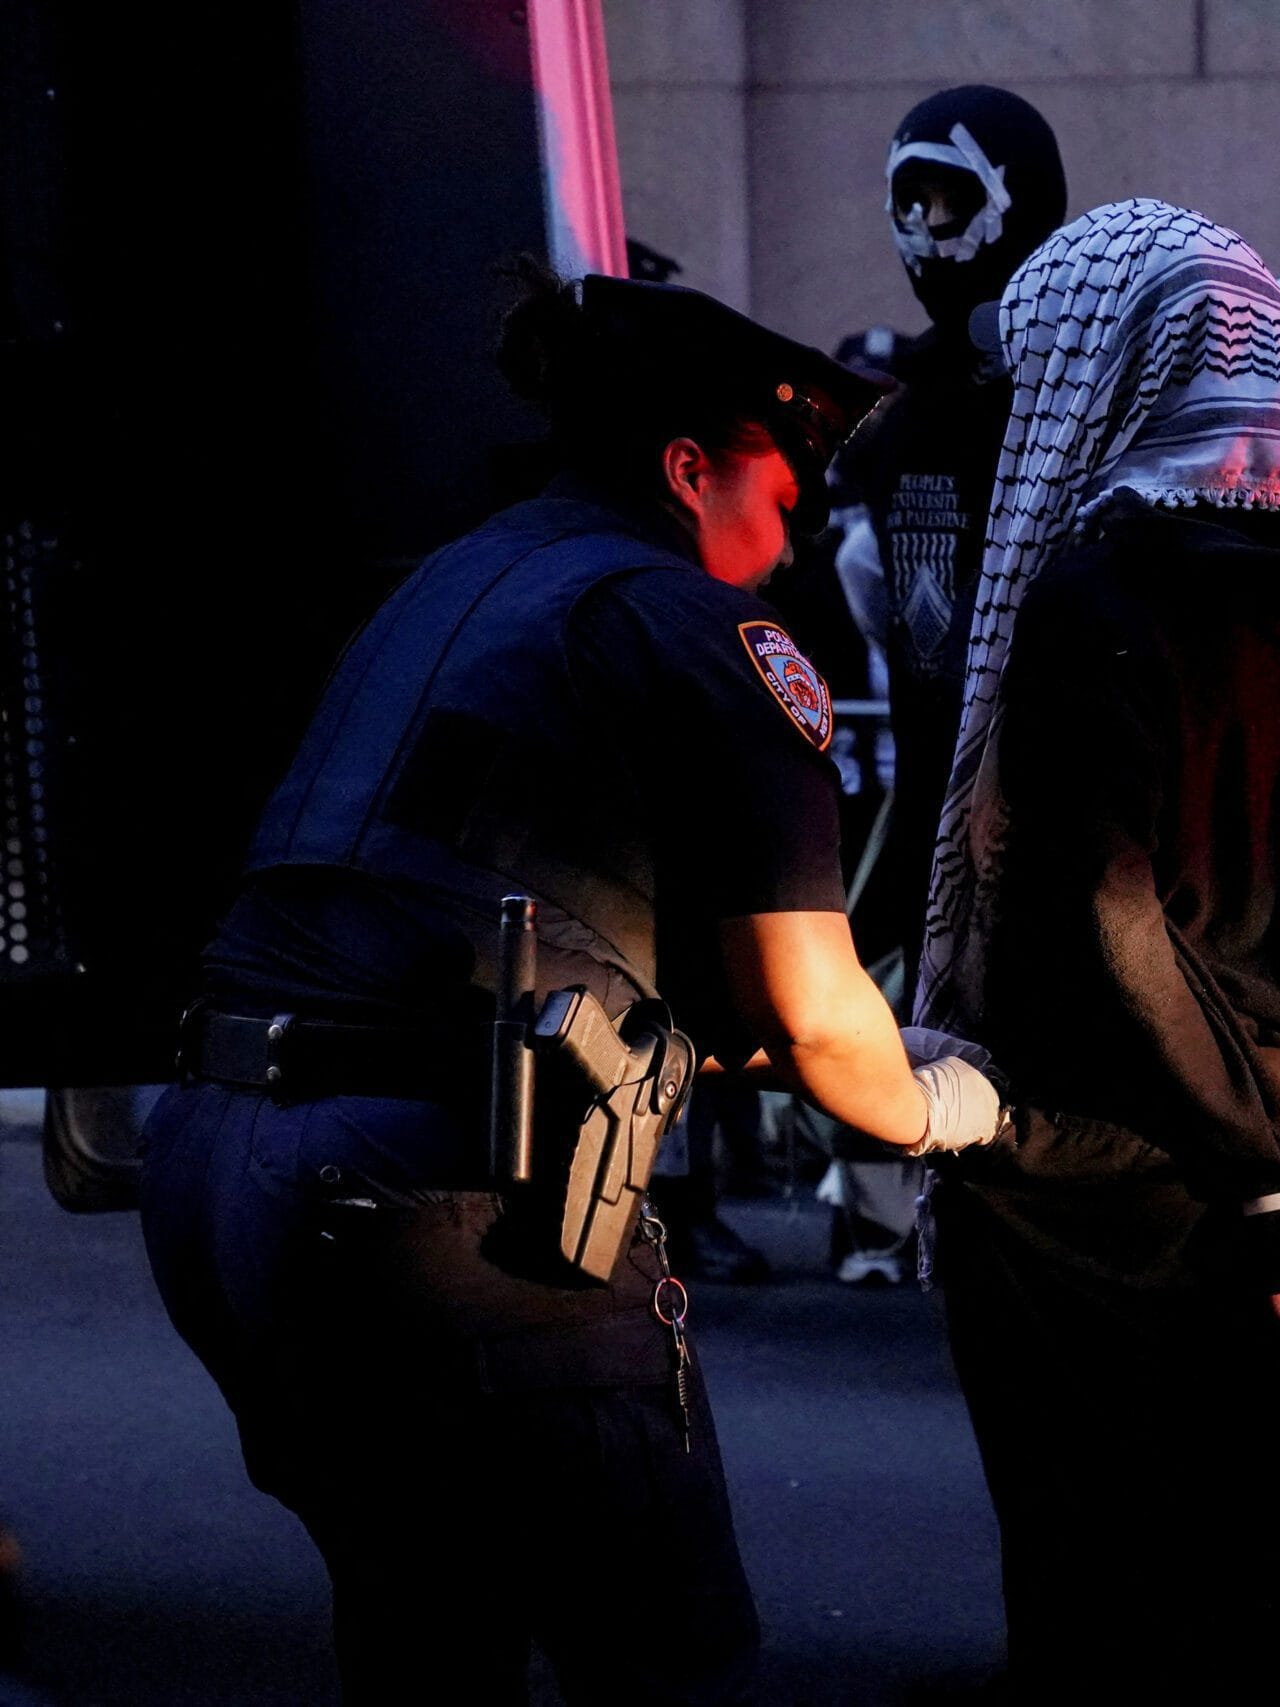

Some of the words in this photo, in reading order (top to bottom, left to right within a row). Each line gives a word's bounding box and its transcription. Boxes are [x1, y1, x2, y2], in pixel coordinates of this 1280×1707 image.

[906, 510, 973, 529] PALESTINE
[766, 671, 791, 702] CITY
[791, 706, 807, 724] OF
